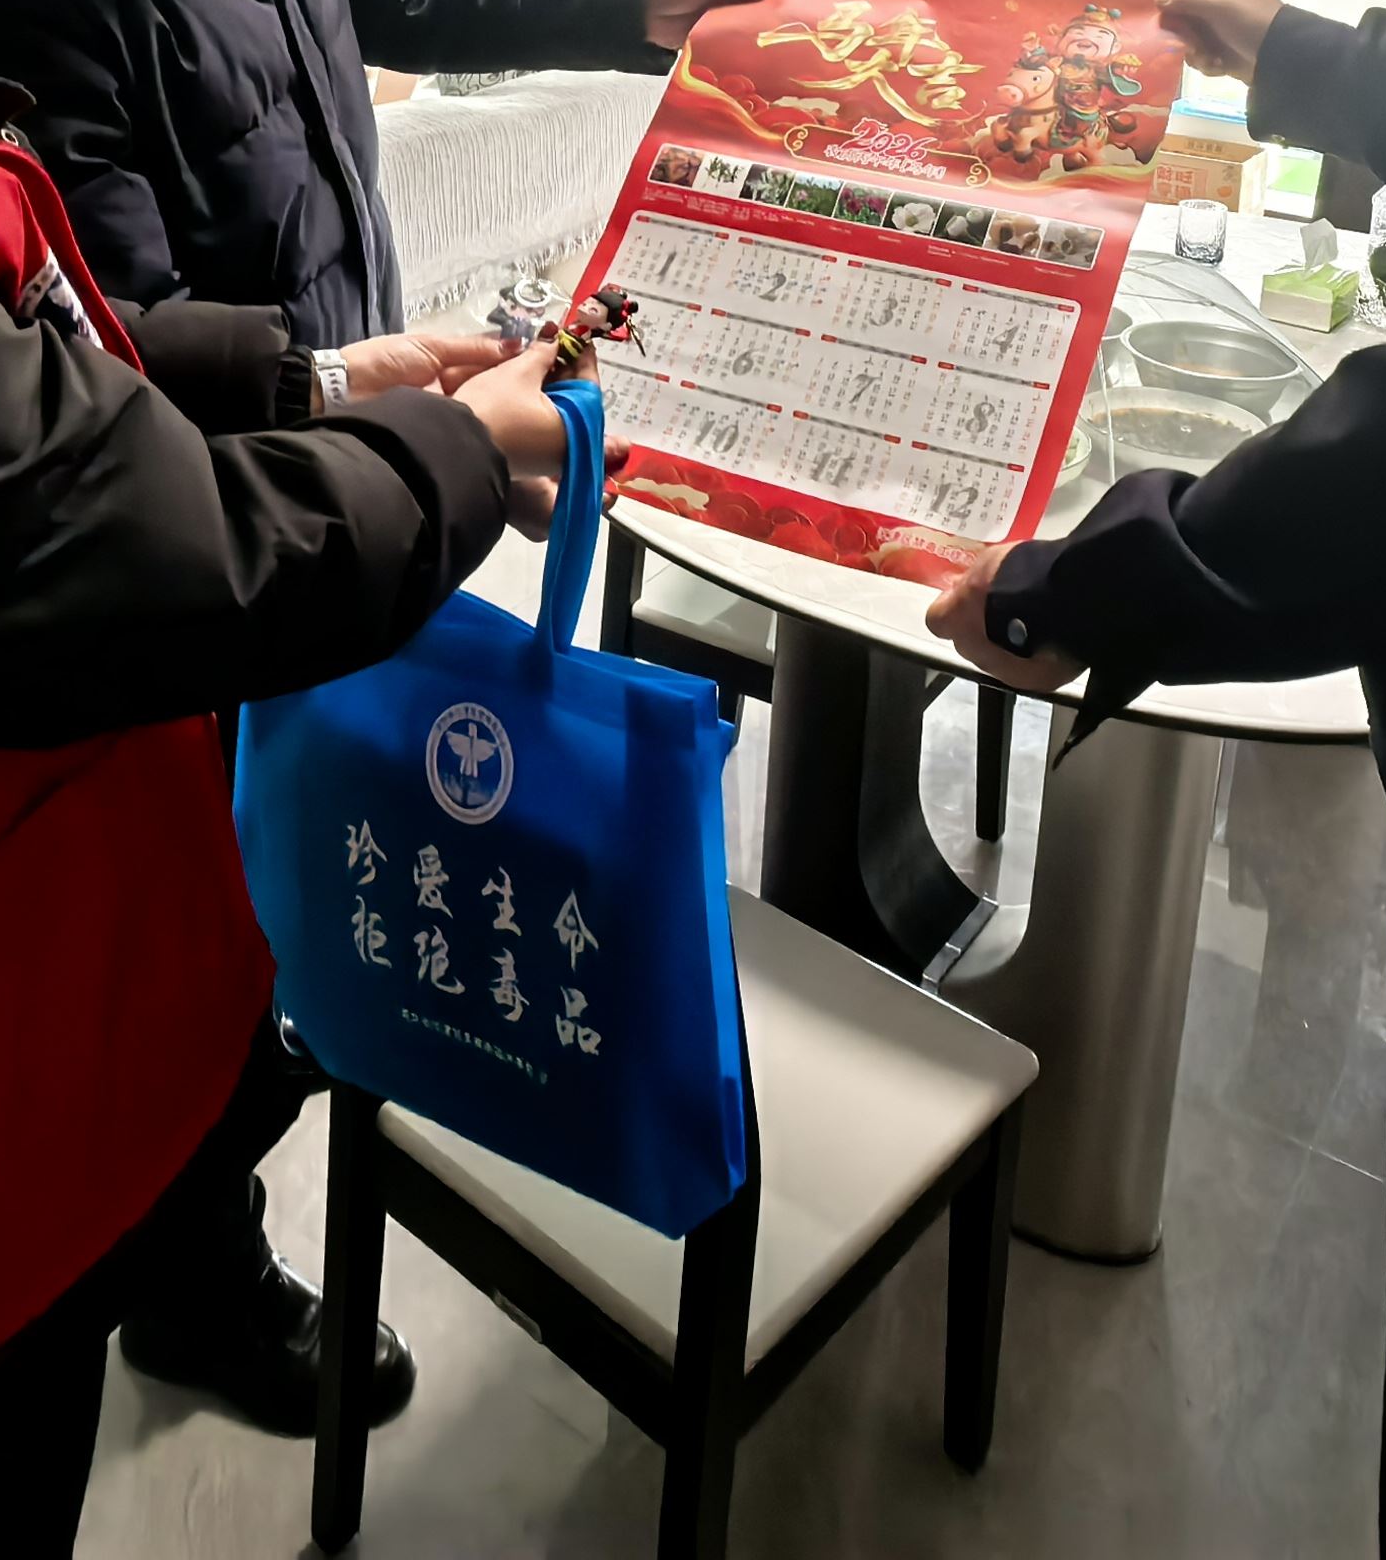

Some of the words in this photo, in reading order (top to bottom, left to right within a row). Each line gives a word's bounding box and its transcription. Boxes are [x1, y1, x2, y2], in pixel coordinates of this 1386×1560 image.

[839, 117, 938, 161] 2026
[759, 273, 786, 302] 2
[993, 323, 1020, 355] 4
[733, 351, 756, 376] 6
[849, 374, 882, 404] 7
[966, 402, 995, 433] 8
[930, 482, 979, 520] 12
[345, 820, 599, 971] 珍爱生命
[351, 896, 602, 1056] 拒绝毒品
